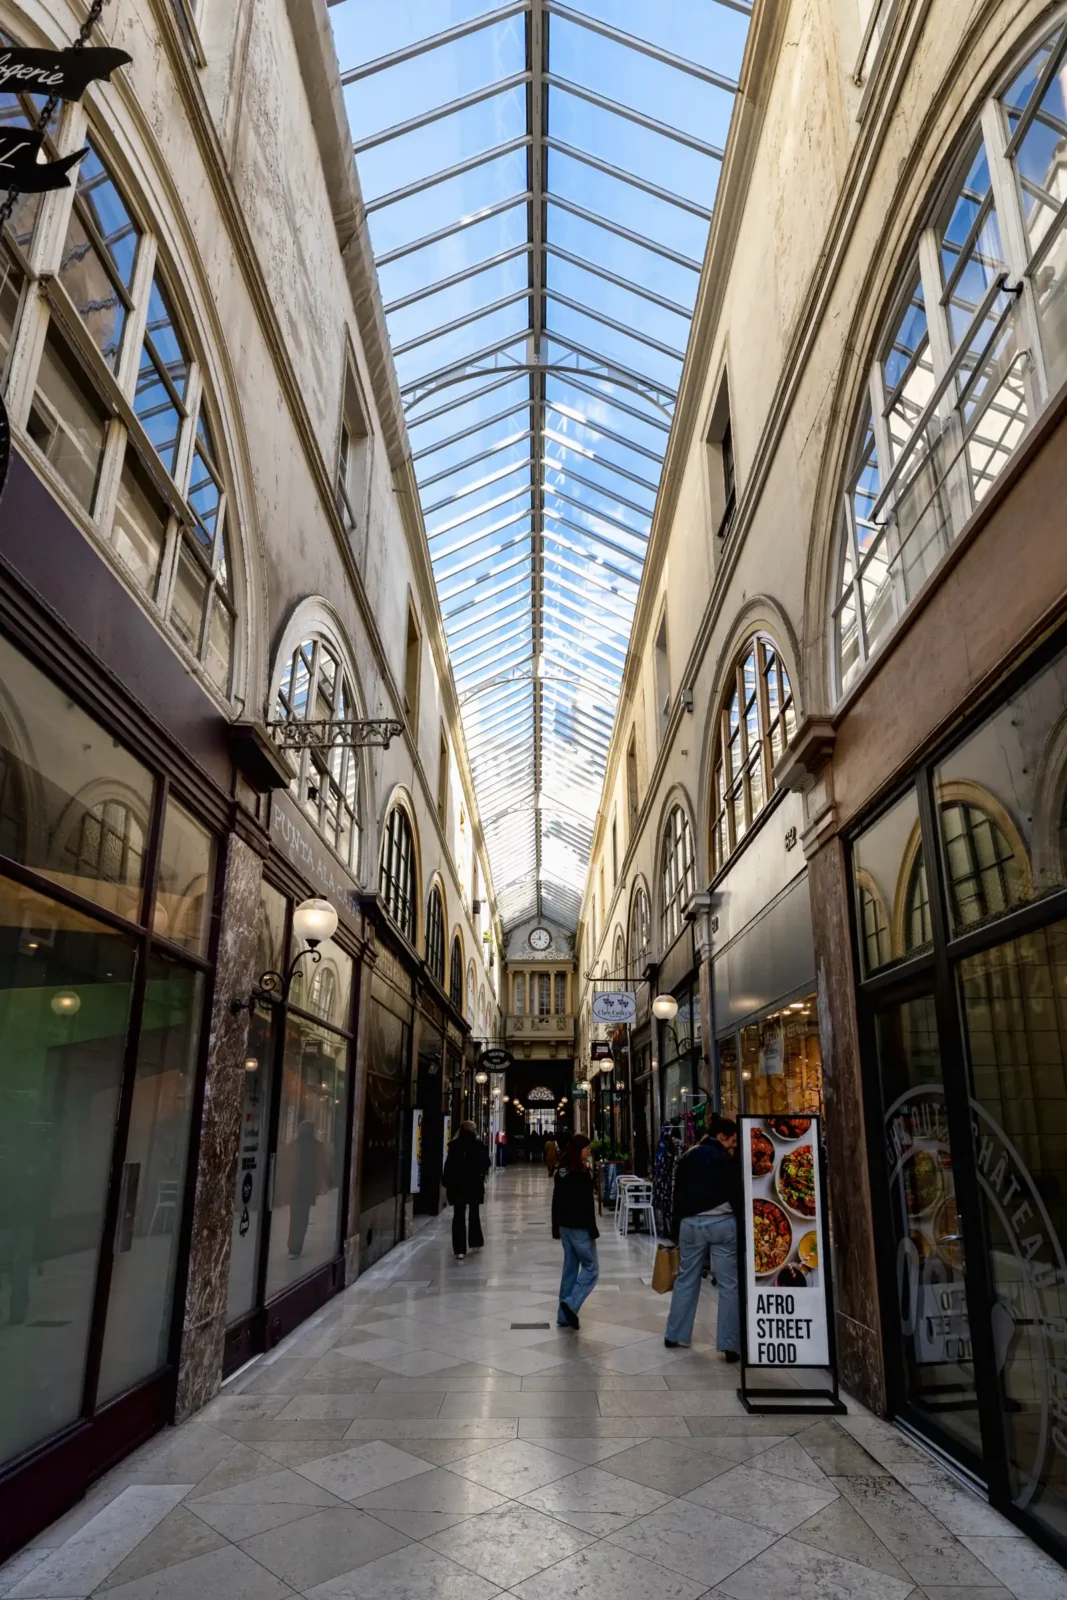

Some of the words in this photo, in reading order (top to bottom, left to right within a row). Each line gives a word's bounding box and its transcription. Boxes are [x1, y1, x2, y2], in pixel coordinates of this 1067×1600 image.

[273, 803, 315, 871] PUNTA
[316, 858, 336, 893] ALA
[756, 1294, 795, 1314] AFRO
[756, 1318, 813, 1340] STREET
[758, 1342, 797, 1363] FOOD
